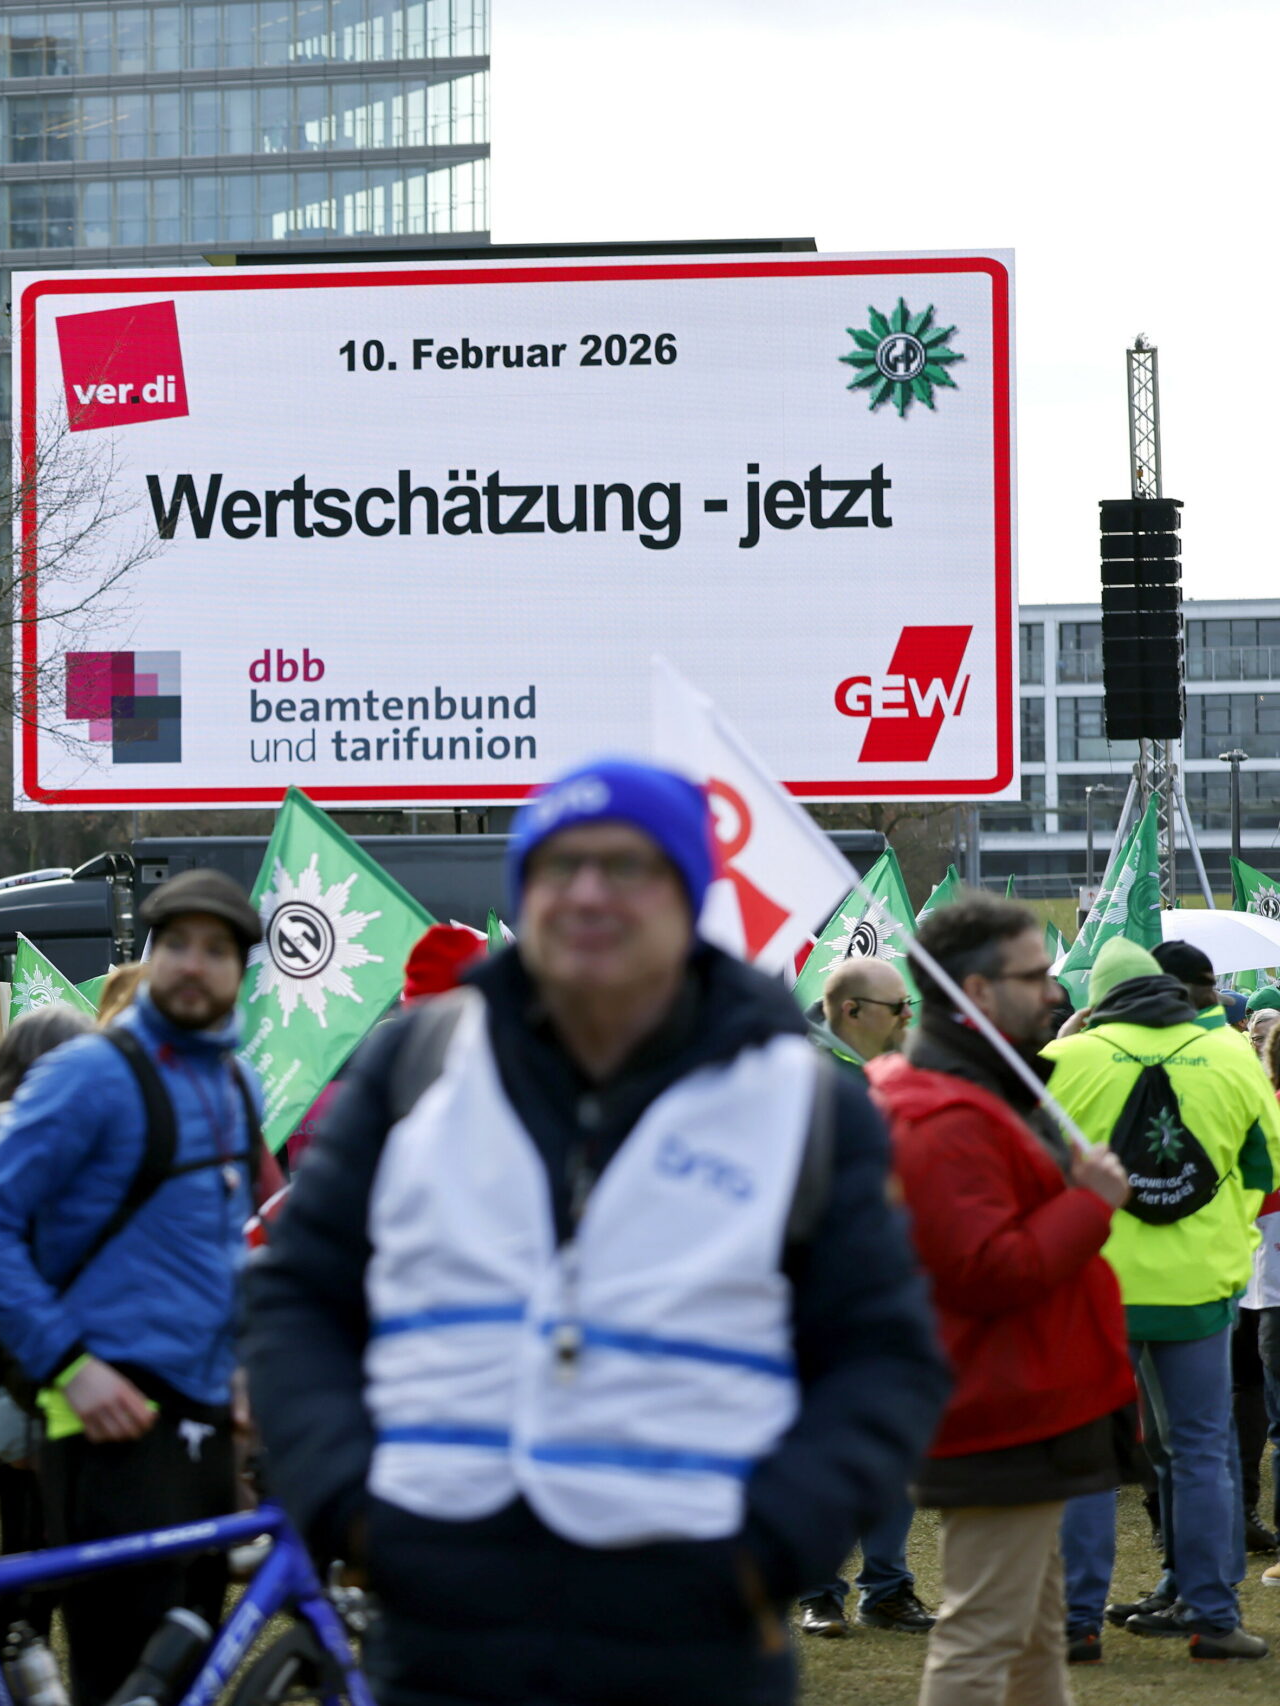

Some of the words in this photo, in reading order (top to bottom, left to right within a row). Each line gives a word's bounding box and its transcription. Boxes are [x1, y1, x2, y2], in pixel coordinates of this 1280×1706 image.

[340, 340, 396, 371] 10.
[413, 338, 567, 370] Februar
[580, 333, 677, 366] 2026
[73, 374, 176, 405] ver.di
[146, 470, 681, 550] Wertschätzung
[704, 500, 727, 512] -
[739, 463, 892, 548] jetzt
[249, 648, 325, 683] dbb
[249, 685, 537, 724] beamtenbund
[834, 673, 971, 718] GEW
[250, 728, 317, 763] und
[331, 725, 538, 762] tarifunion
